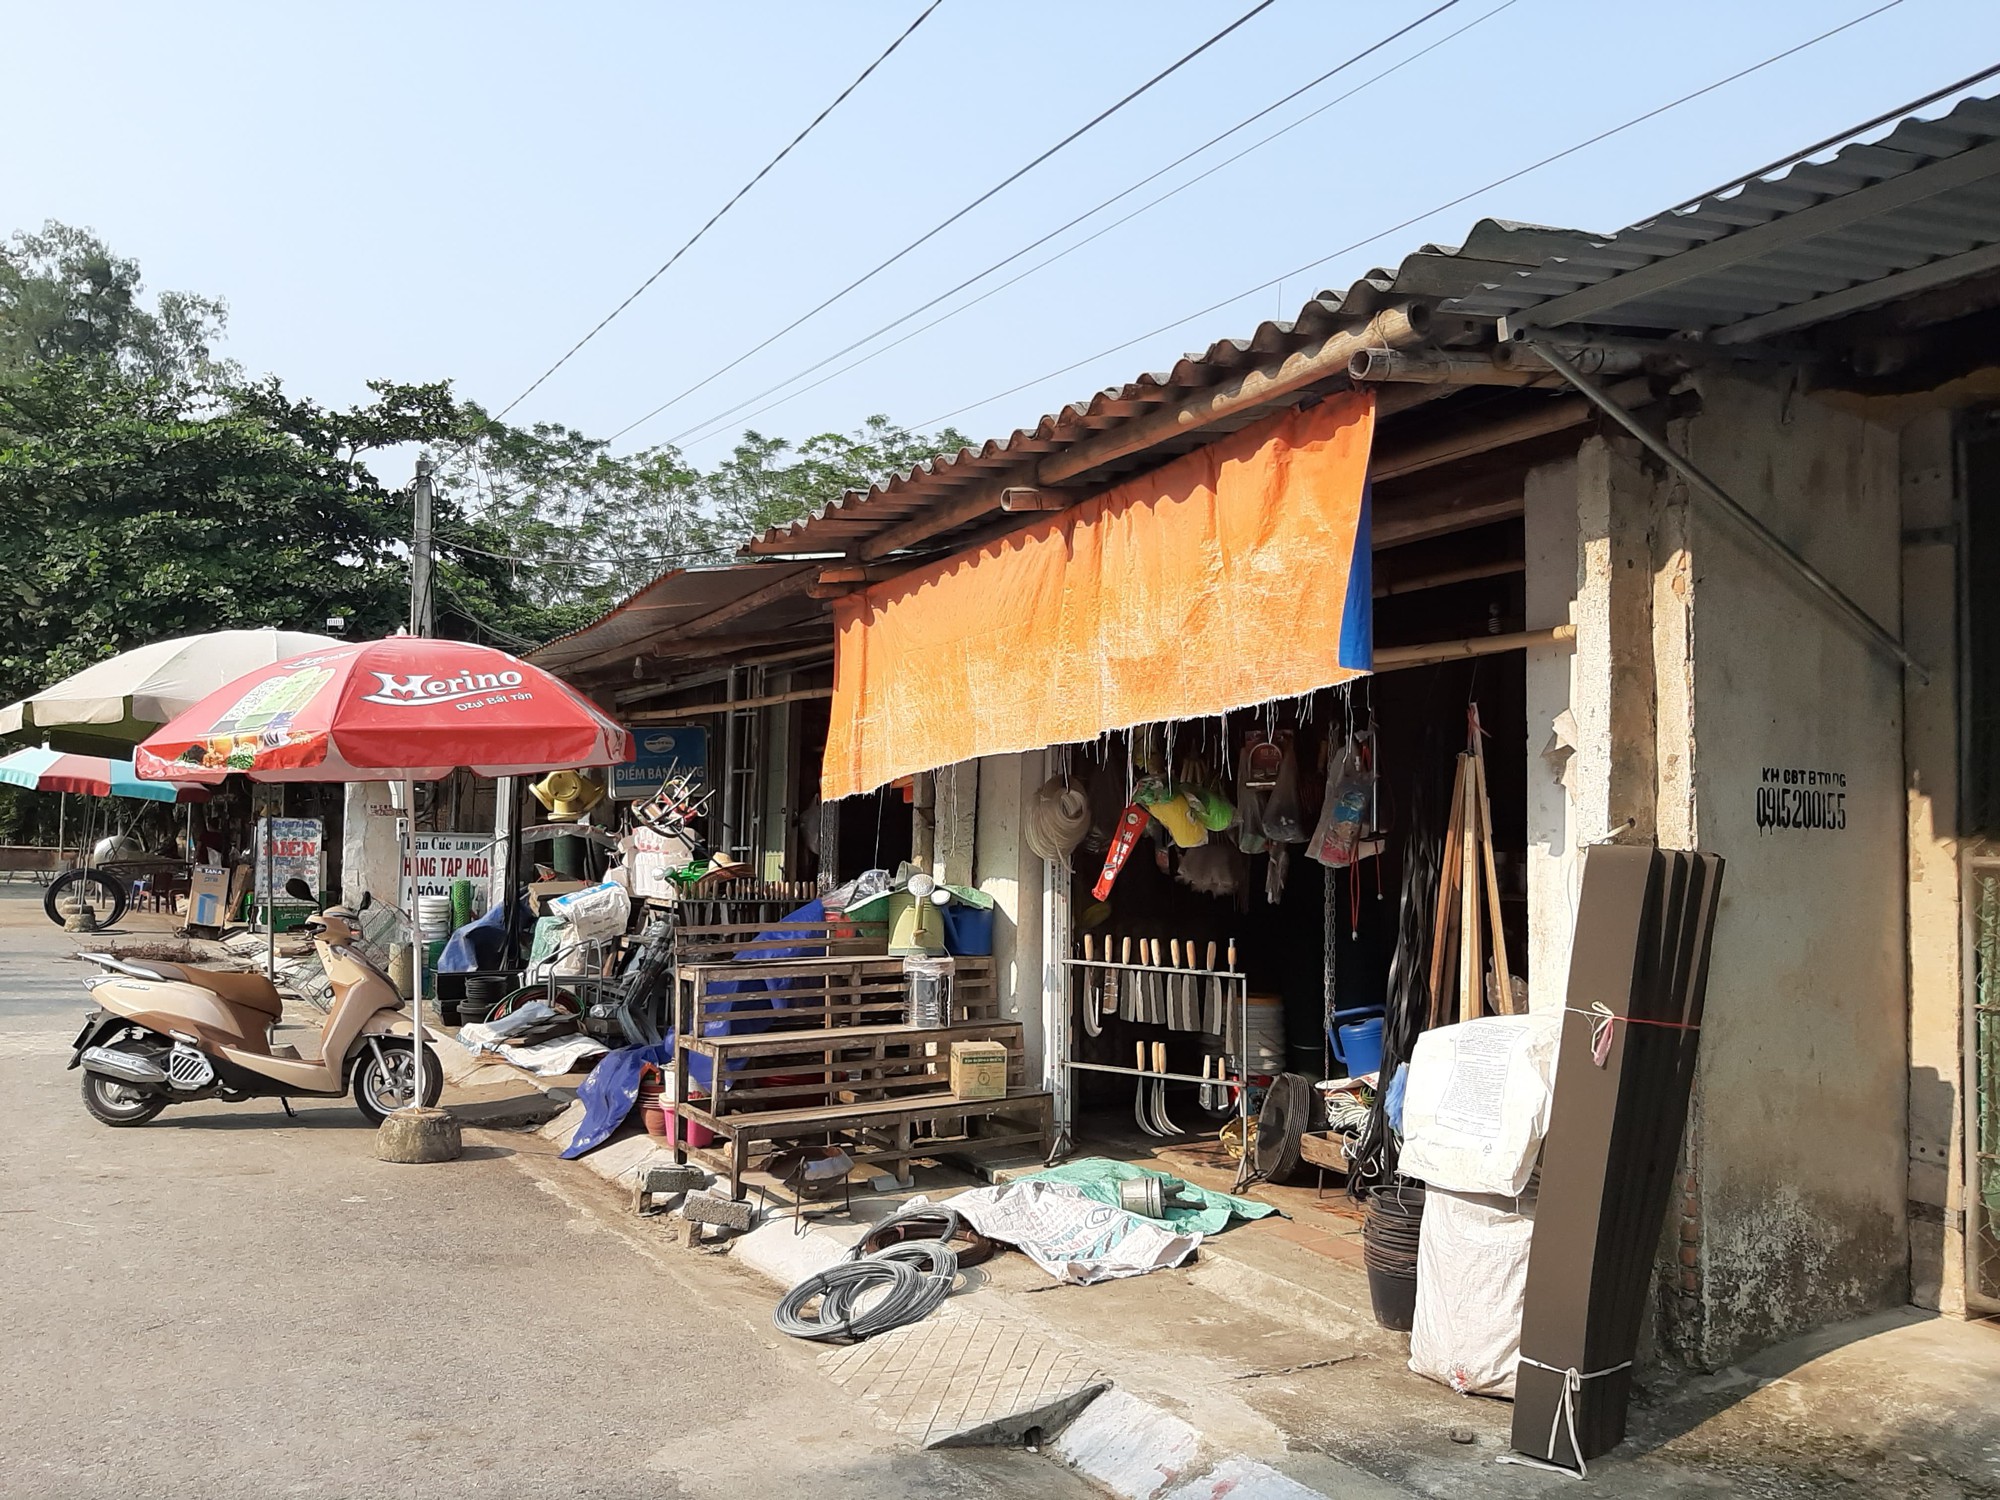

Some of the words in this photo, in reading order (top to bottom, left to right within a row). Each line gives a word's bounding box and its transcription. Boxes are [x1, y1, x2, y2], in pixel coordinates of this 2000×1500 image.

[368, 669, 523, 700] Merino
[1762, 766, 1780, 783] KH
[1756, 786, 1847, 831] 0915200155
[431, 836, 452, 851] Cúc
[455, 841, 470, 851] LAM
